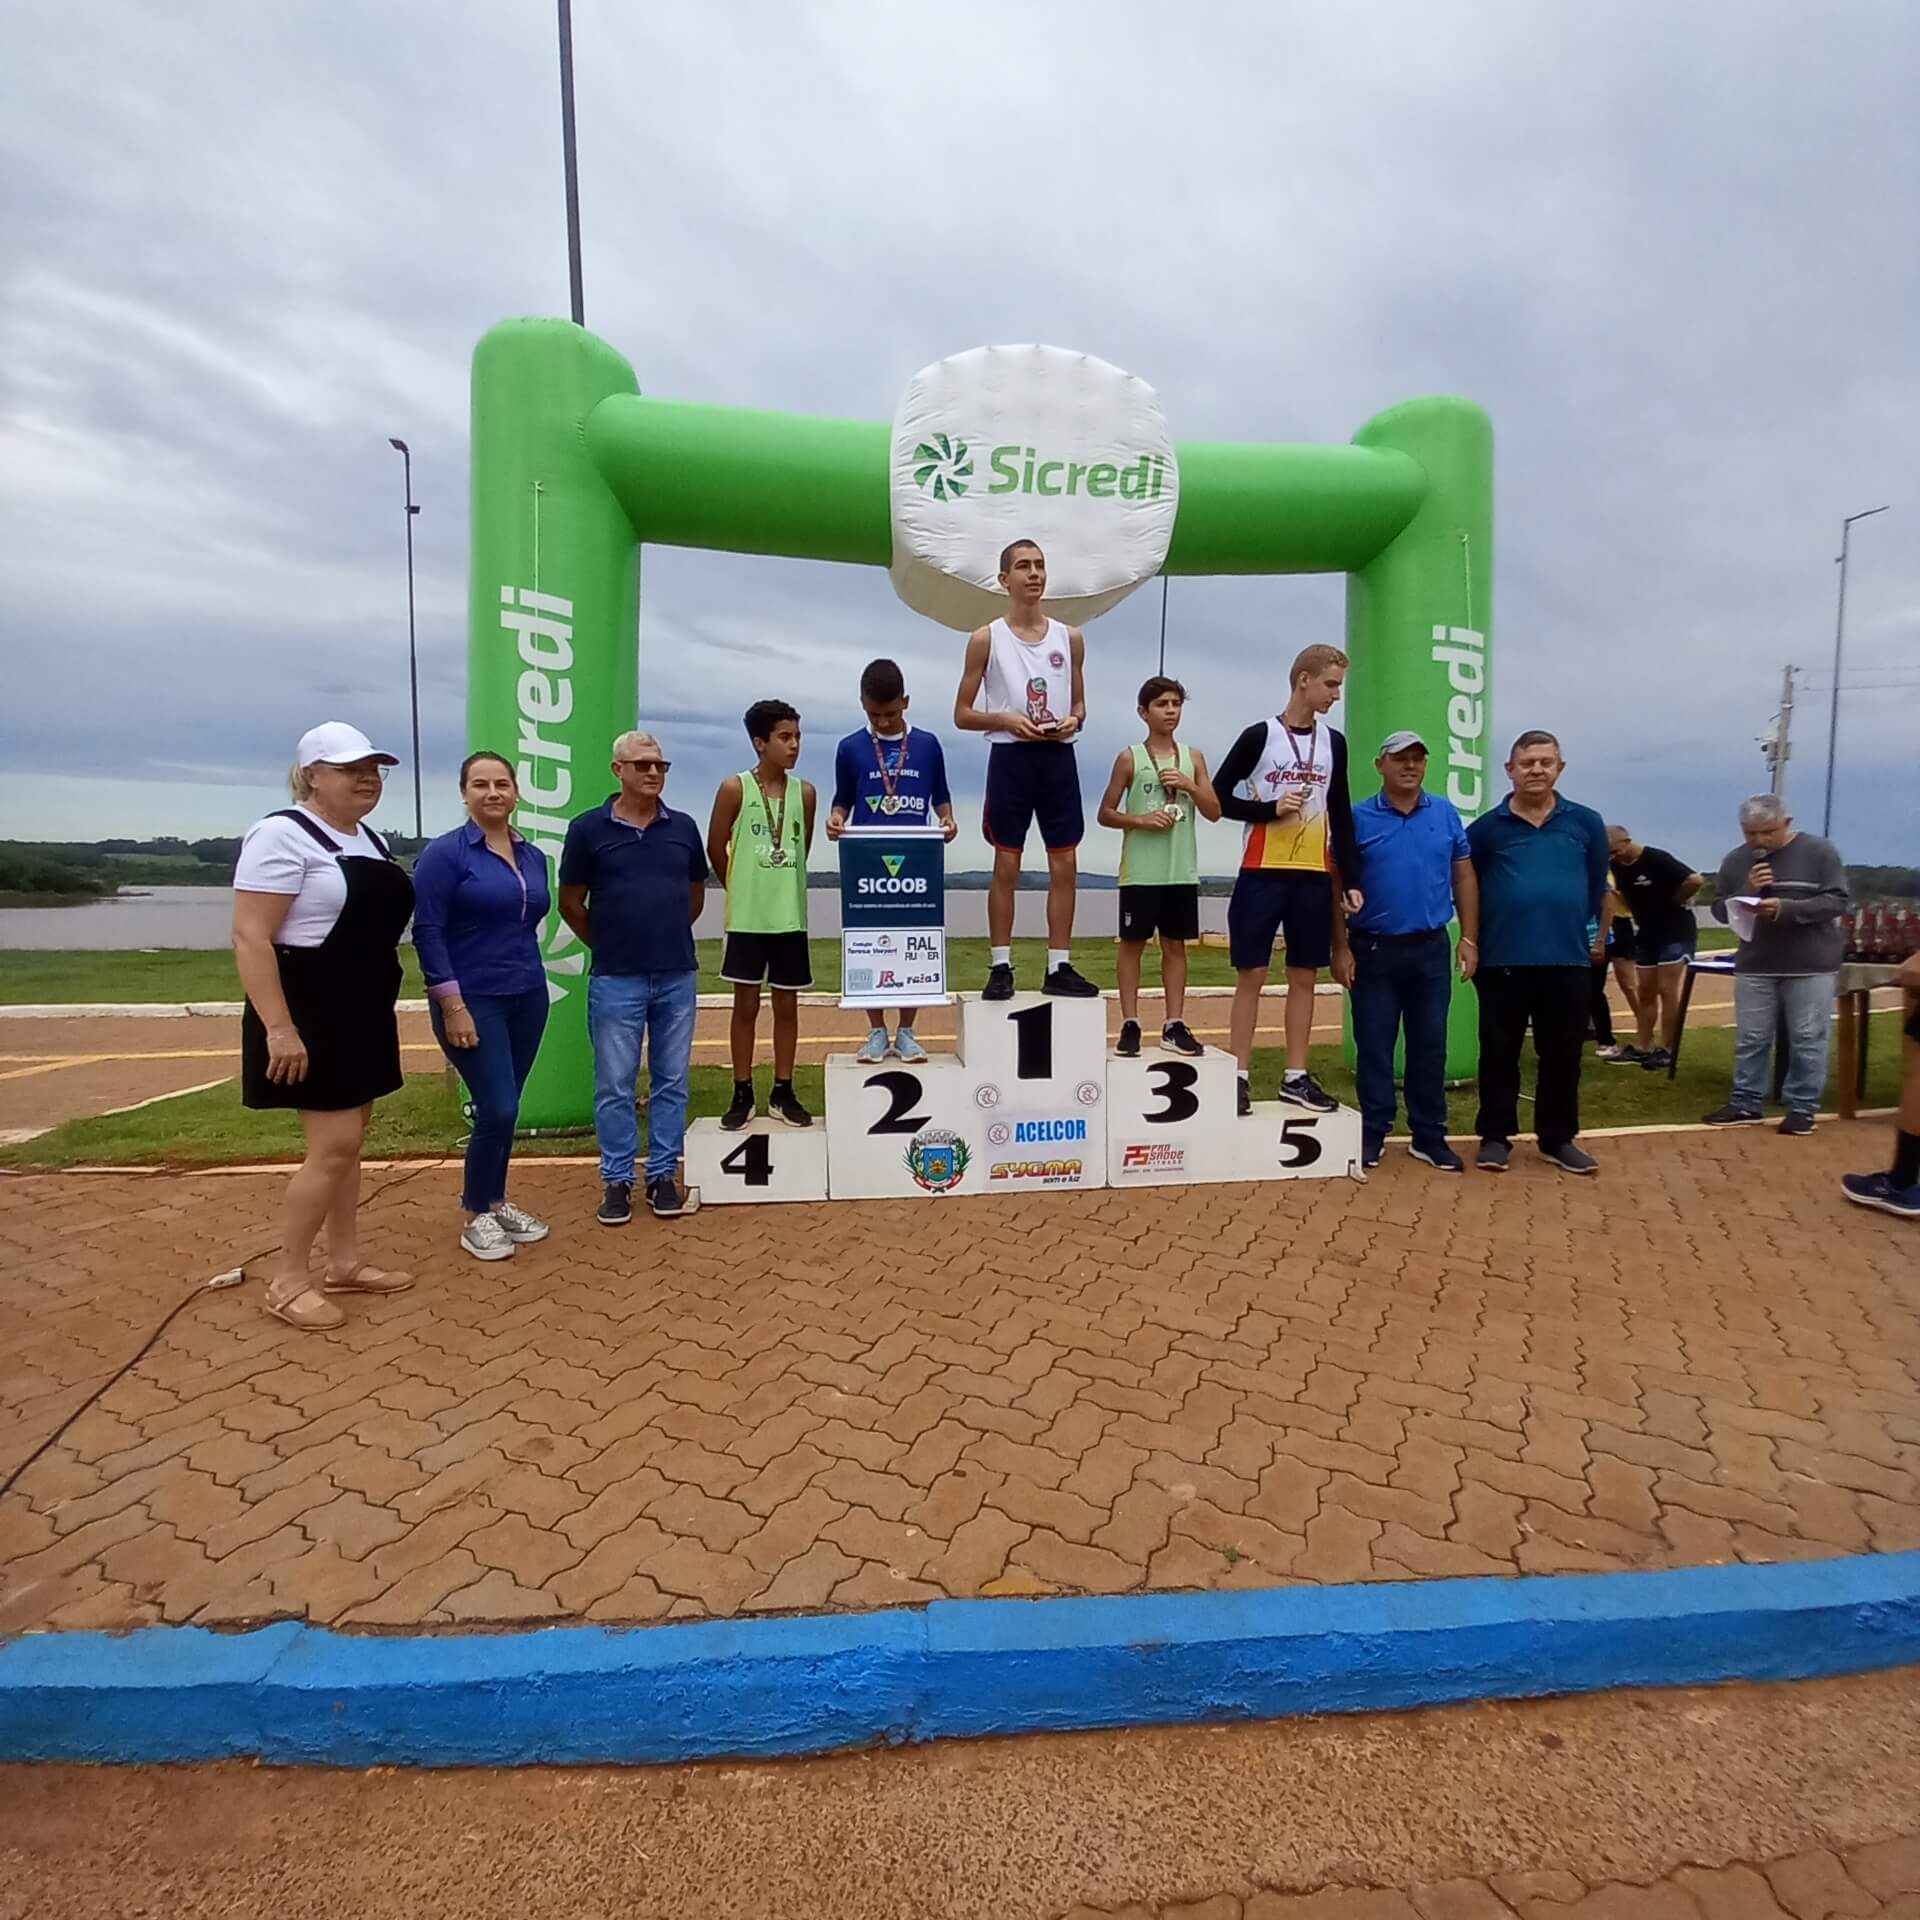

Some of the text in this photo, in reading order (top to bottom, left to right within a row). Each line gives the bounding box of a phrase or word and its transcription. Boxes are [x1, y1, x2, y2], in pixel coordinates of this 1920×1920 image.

[988, 446, 1165, 499] Sicredi
[500, 585, 574, 888] icredi
[1432, 624, 1484, 829] credi
[857, 878, 928, 894] SICOOB
[907, 936, 937, 951] RAL
[1008, 1002, 1052, 1079] 1
[864, 1072, 931, 1134] 2
[1143, 1062, 1198, 1123] 3
[1015, 1120, 1086, 1142] ACELCOR
[1280, 1118, 1321, 1168] 5
[721, 1135, 774, 1186] 4
